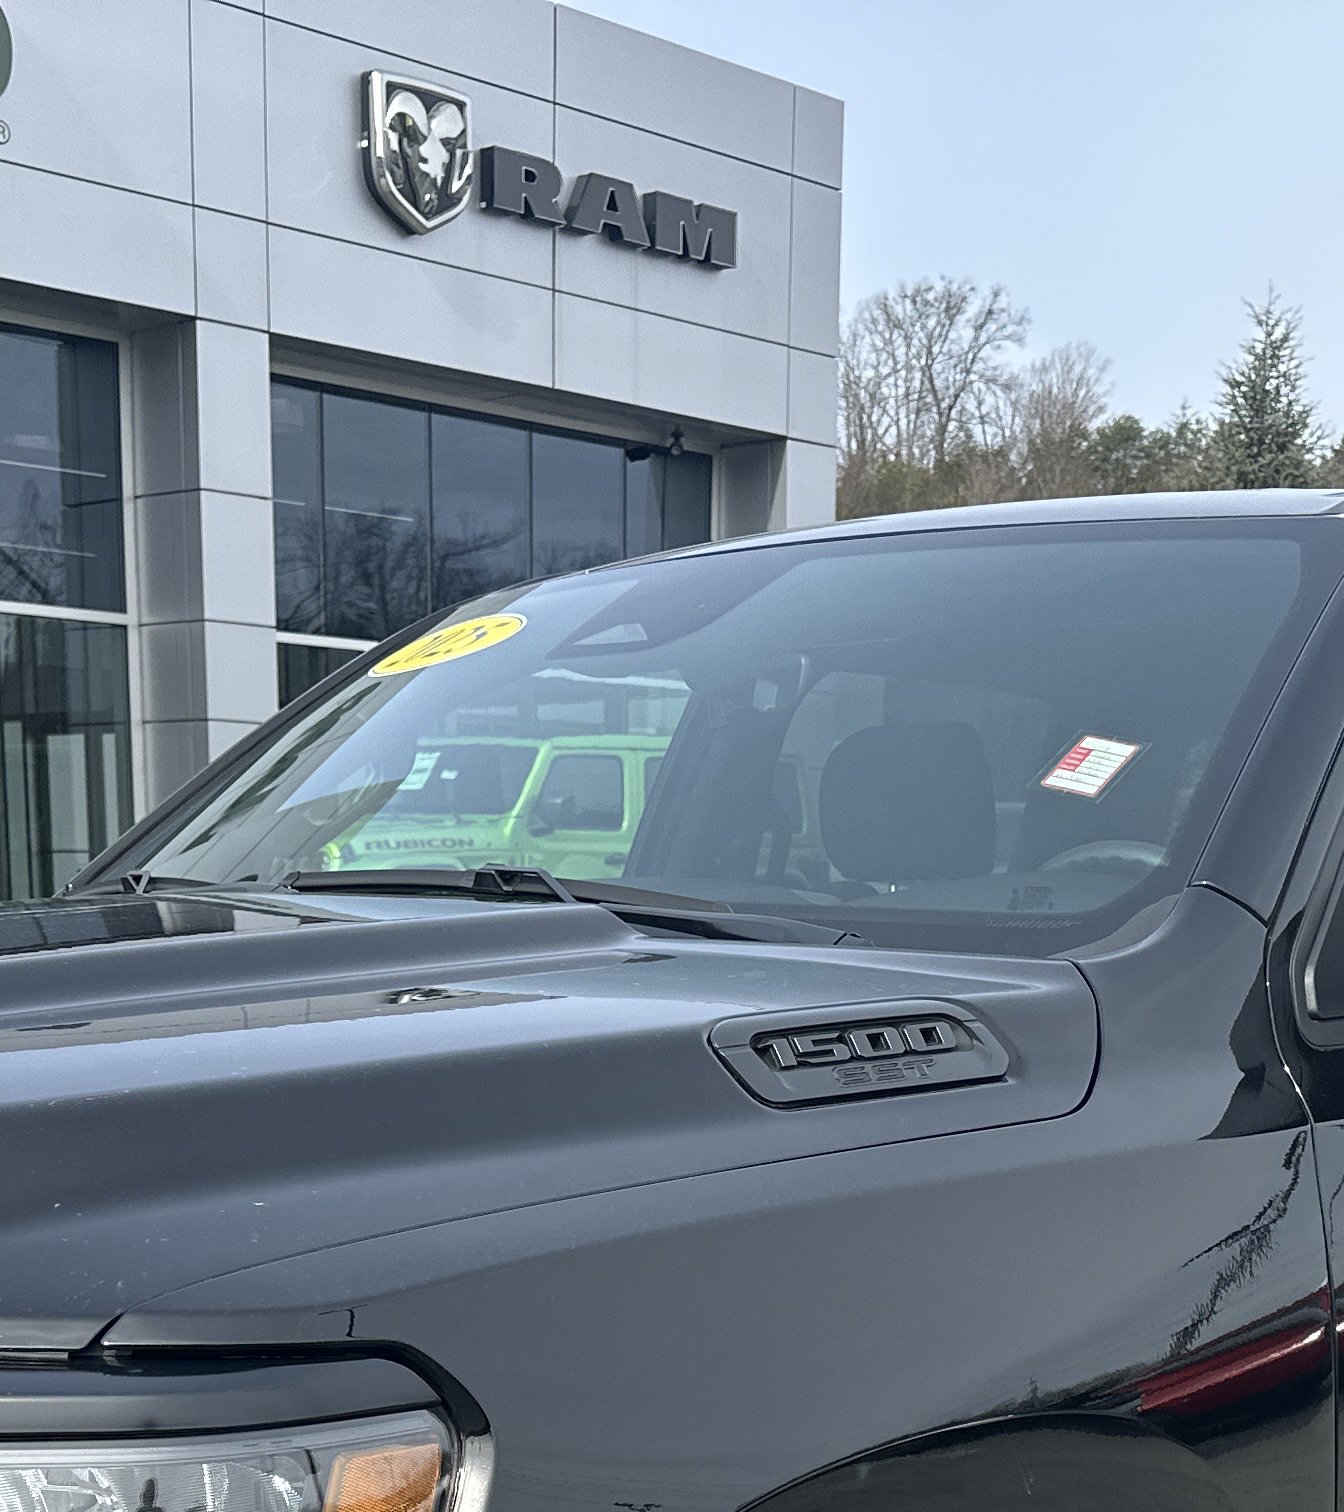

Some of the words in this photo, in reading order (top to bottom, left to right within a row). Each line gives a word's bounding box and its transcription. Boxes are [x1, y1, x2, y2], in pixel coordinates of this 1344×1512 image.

[479, 144, 739, 270] RAM
[363, 838, 476, 851] RUBICON
[756, 1021, 958, 1070] 1500
[831, 1057, 937, 1088] SST
